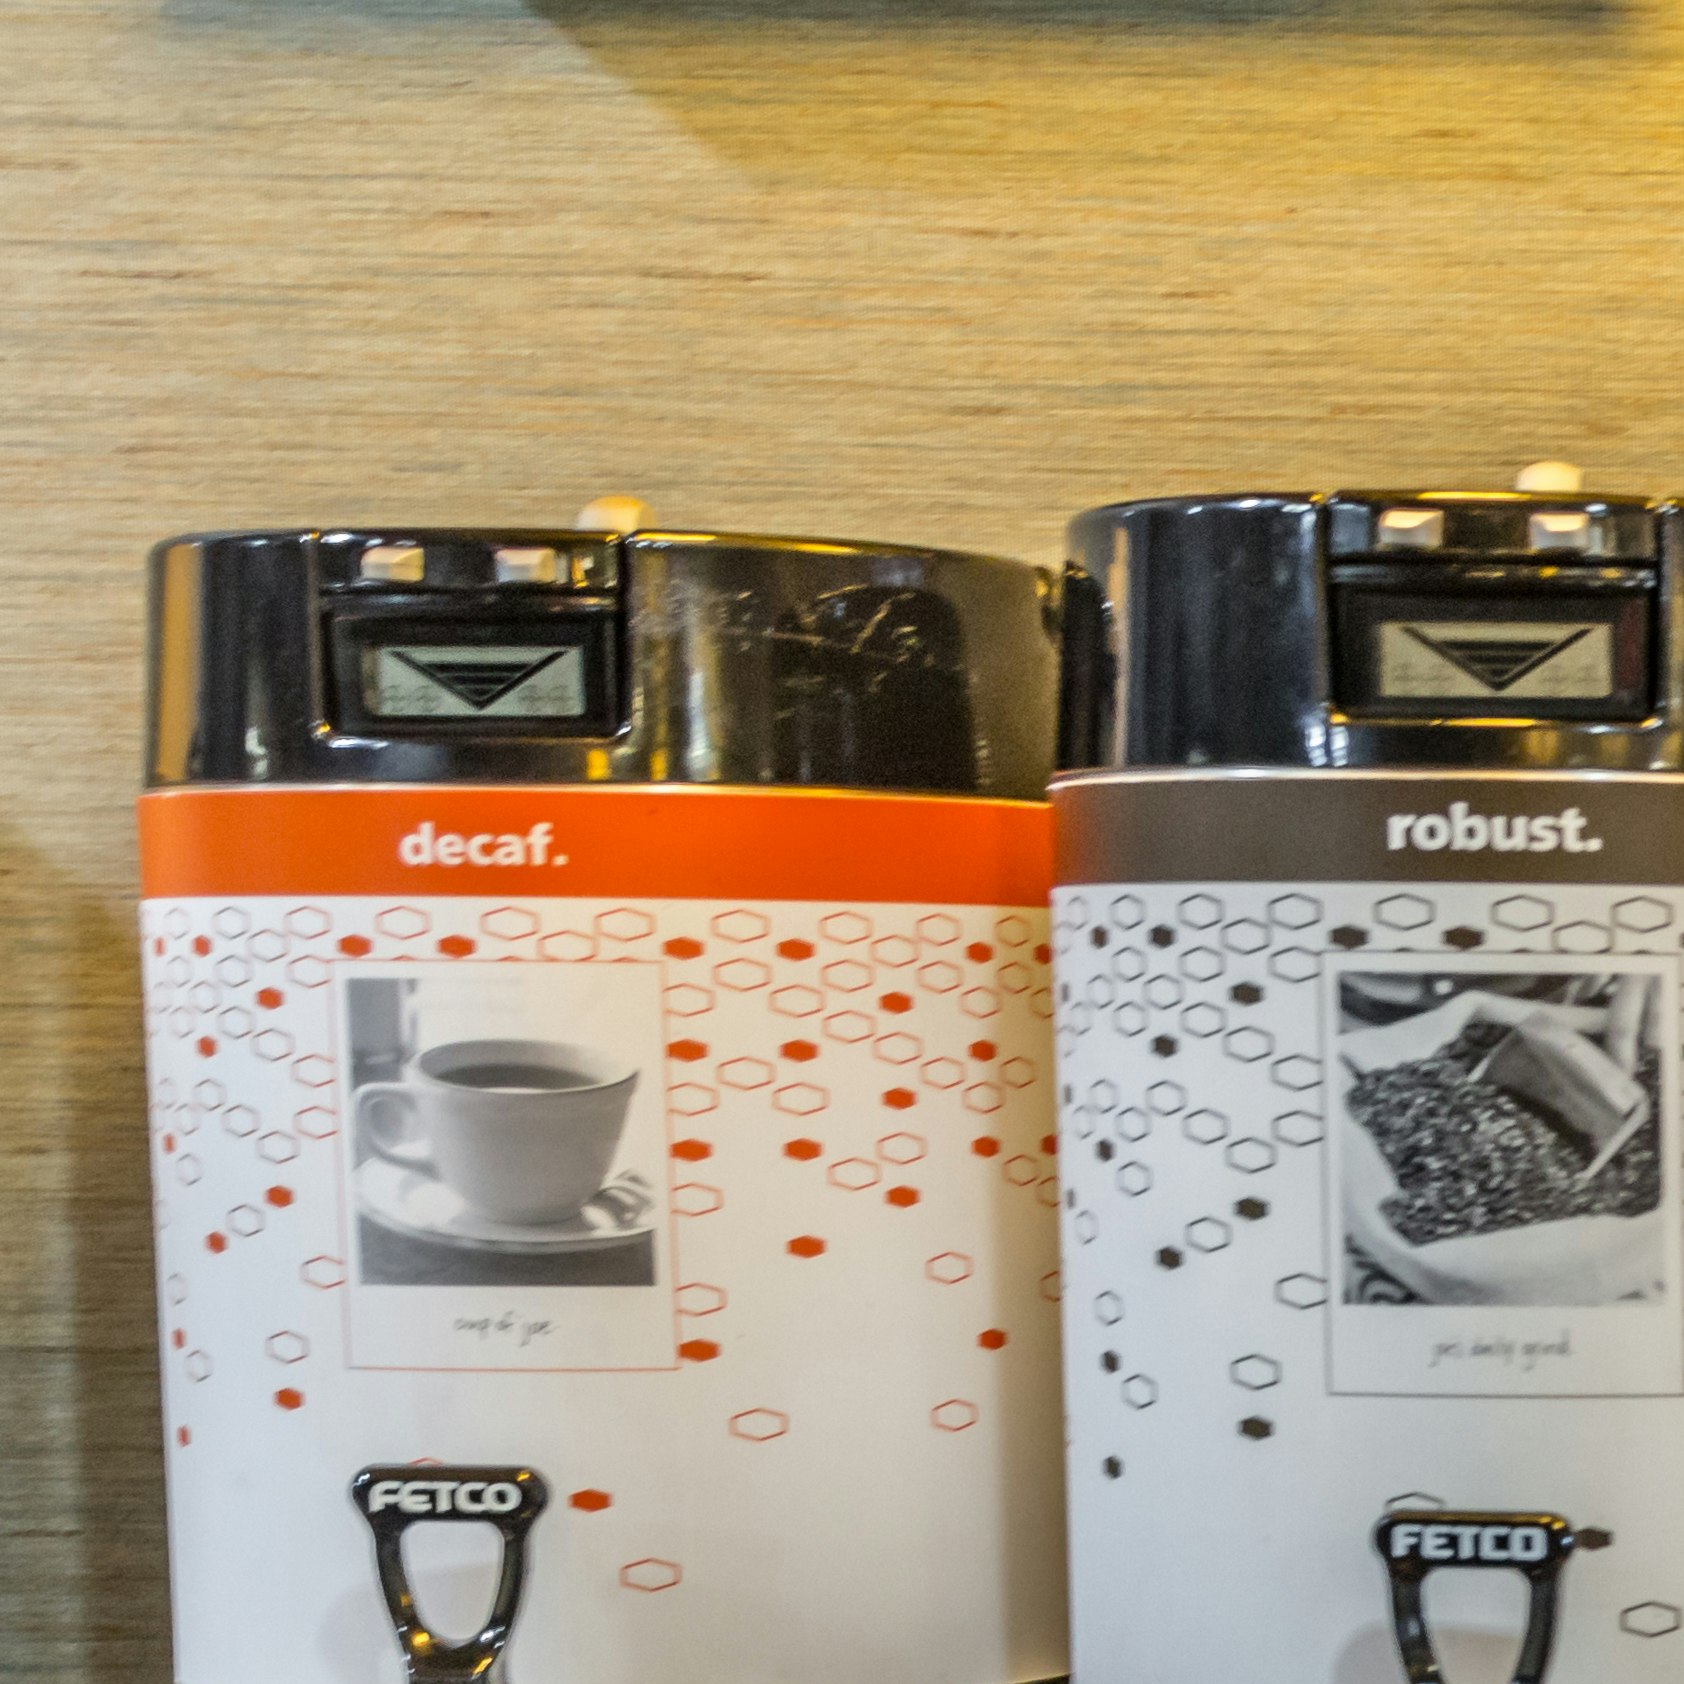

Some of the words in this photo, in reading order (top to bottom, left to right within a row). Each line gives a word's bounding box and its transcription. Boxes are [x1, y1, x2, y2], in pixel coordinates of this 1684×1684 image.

[399, 820, 569, 866] decaf.
[1387, 801, 1602, 852] robust.
[368, 1480, 522, 1514] FETCO
[1390, 1523, 1547, 1561] FETCO
